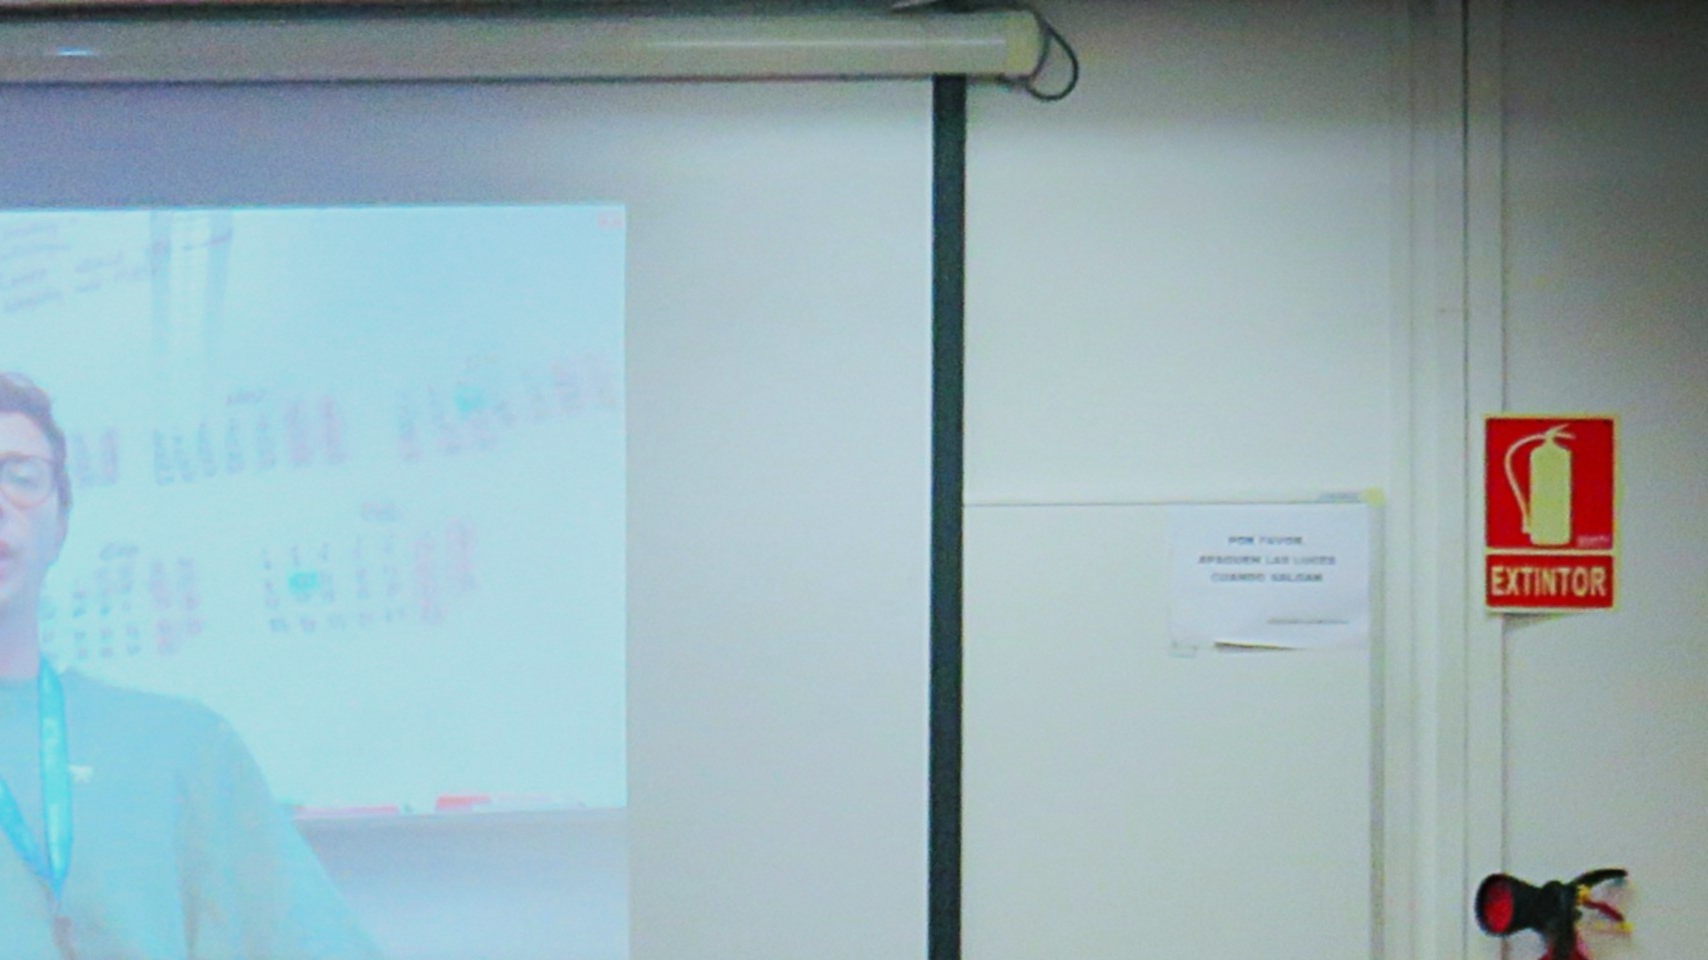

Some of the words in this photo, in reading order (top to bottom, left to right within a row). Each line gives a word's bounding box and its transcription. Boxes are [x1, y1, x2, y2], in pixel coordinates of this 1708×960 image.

[1228, 536, 1254, 545] POR
[1259, 536, 1303, 545] FAVOR
[1198, 556, 1261, 565] APAGUEN
[1266, 556, 1289, 565] LAS
[1294, 556, 1336, 565] LUCES
[1211, 573, 1266, 582] CUANDO
[1271, 573, 1323, 582] SALGAN
[1491, 566, 1606, 597] EXTINTOR
